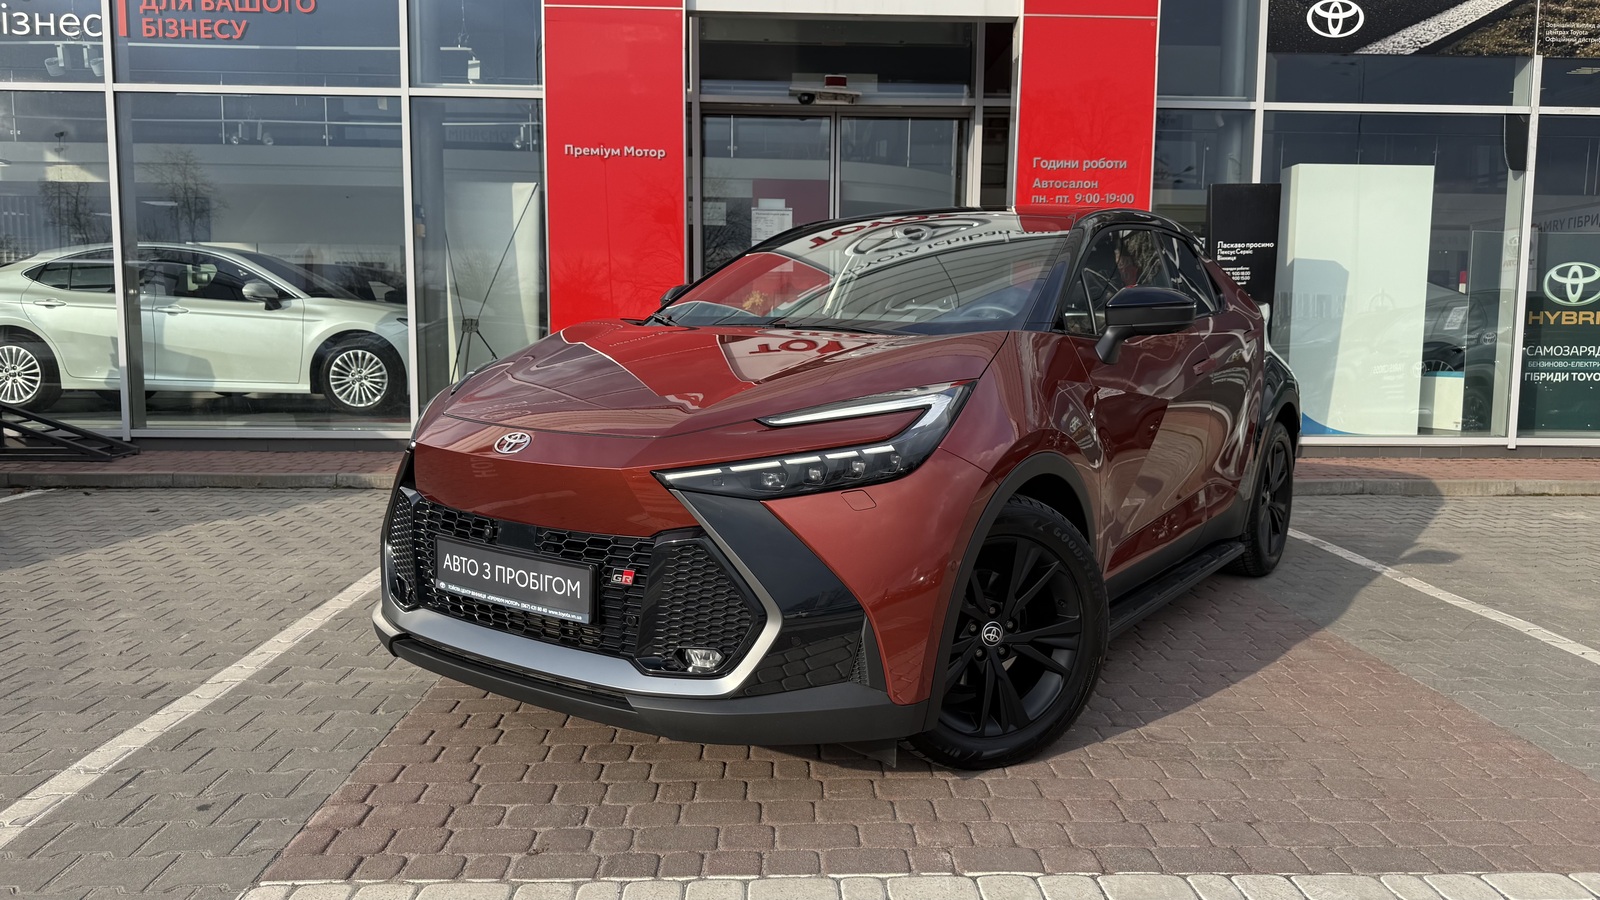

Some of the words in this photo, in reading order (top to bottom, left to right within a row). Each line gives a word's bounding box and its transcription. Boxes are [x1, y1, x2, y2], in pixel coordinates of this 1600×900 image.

[142, 18, 248, 39] БІЗНЕСУ
[564, 144, 621, 159] Преміум
[623, 146, 667, 160] Мотор
[1033, 157, 1079, 170] Години
[1082, 158, 1128, 171] роботи
[1032, 178, 1099, 188] Автосалон
[1524, 372, 1569, 382] ГІБРИДИ
[443, 553, 479, 576] АВТО
[495, 565, 581, 599] ПРОБІГОМ
[613, 574, 633, 584] GR
